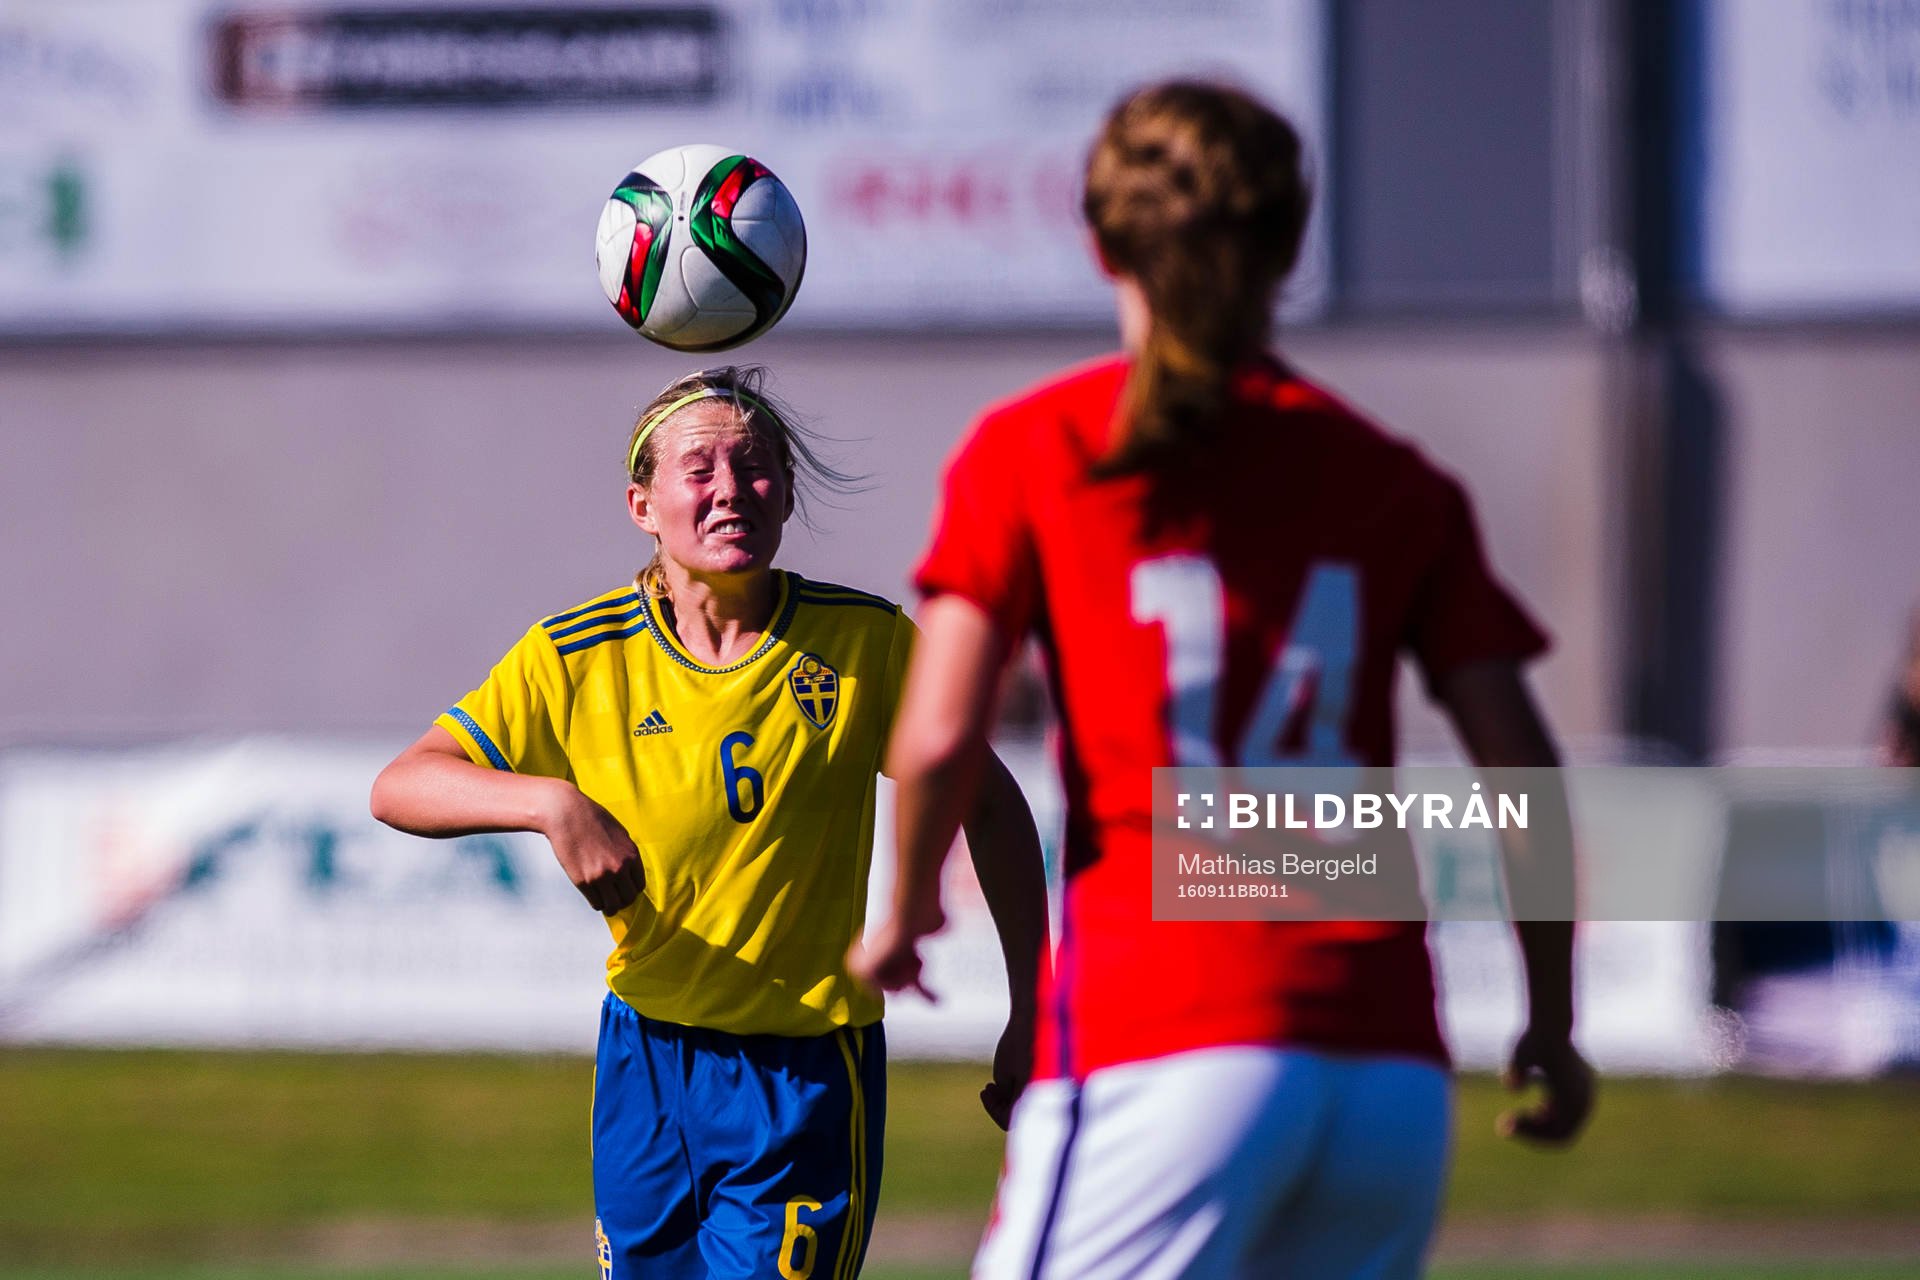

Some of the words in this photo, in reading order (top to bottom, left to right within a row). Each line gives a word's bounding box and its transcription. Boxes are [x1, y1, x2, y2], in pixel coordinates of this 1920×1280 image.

[633, 725, 673, 736] adidas
[1131, 553, 1367, 842] 14
[720, 731, 764, 823] 6
[777, 1194, 822, 1280] 6
